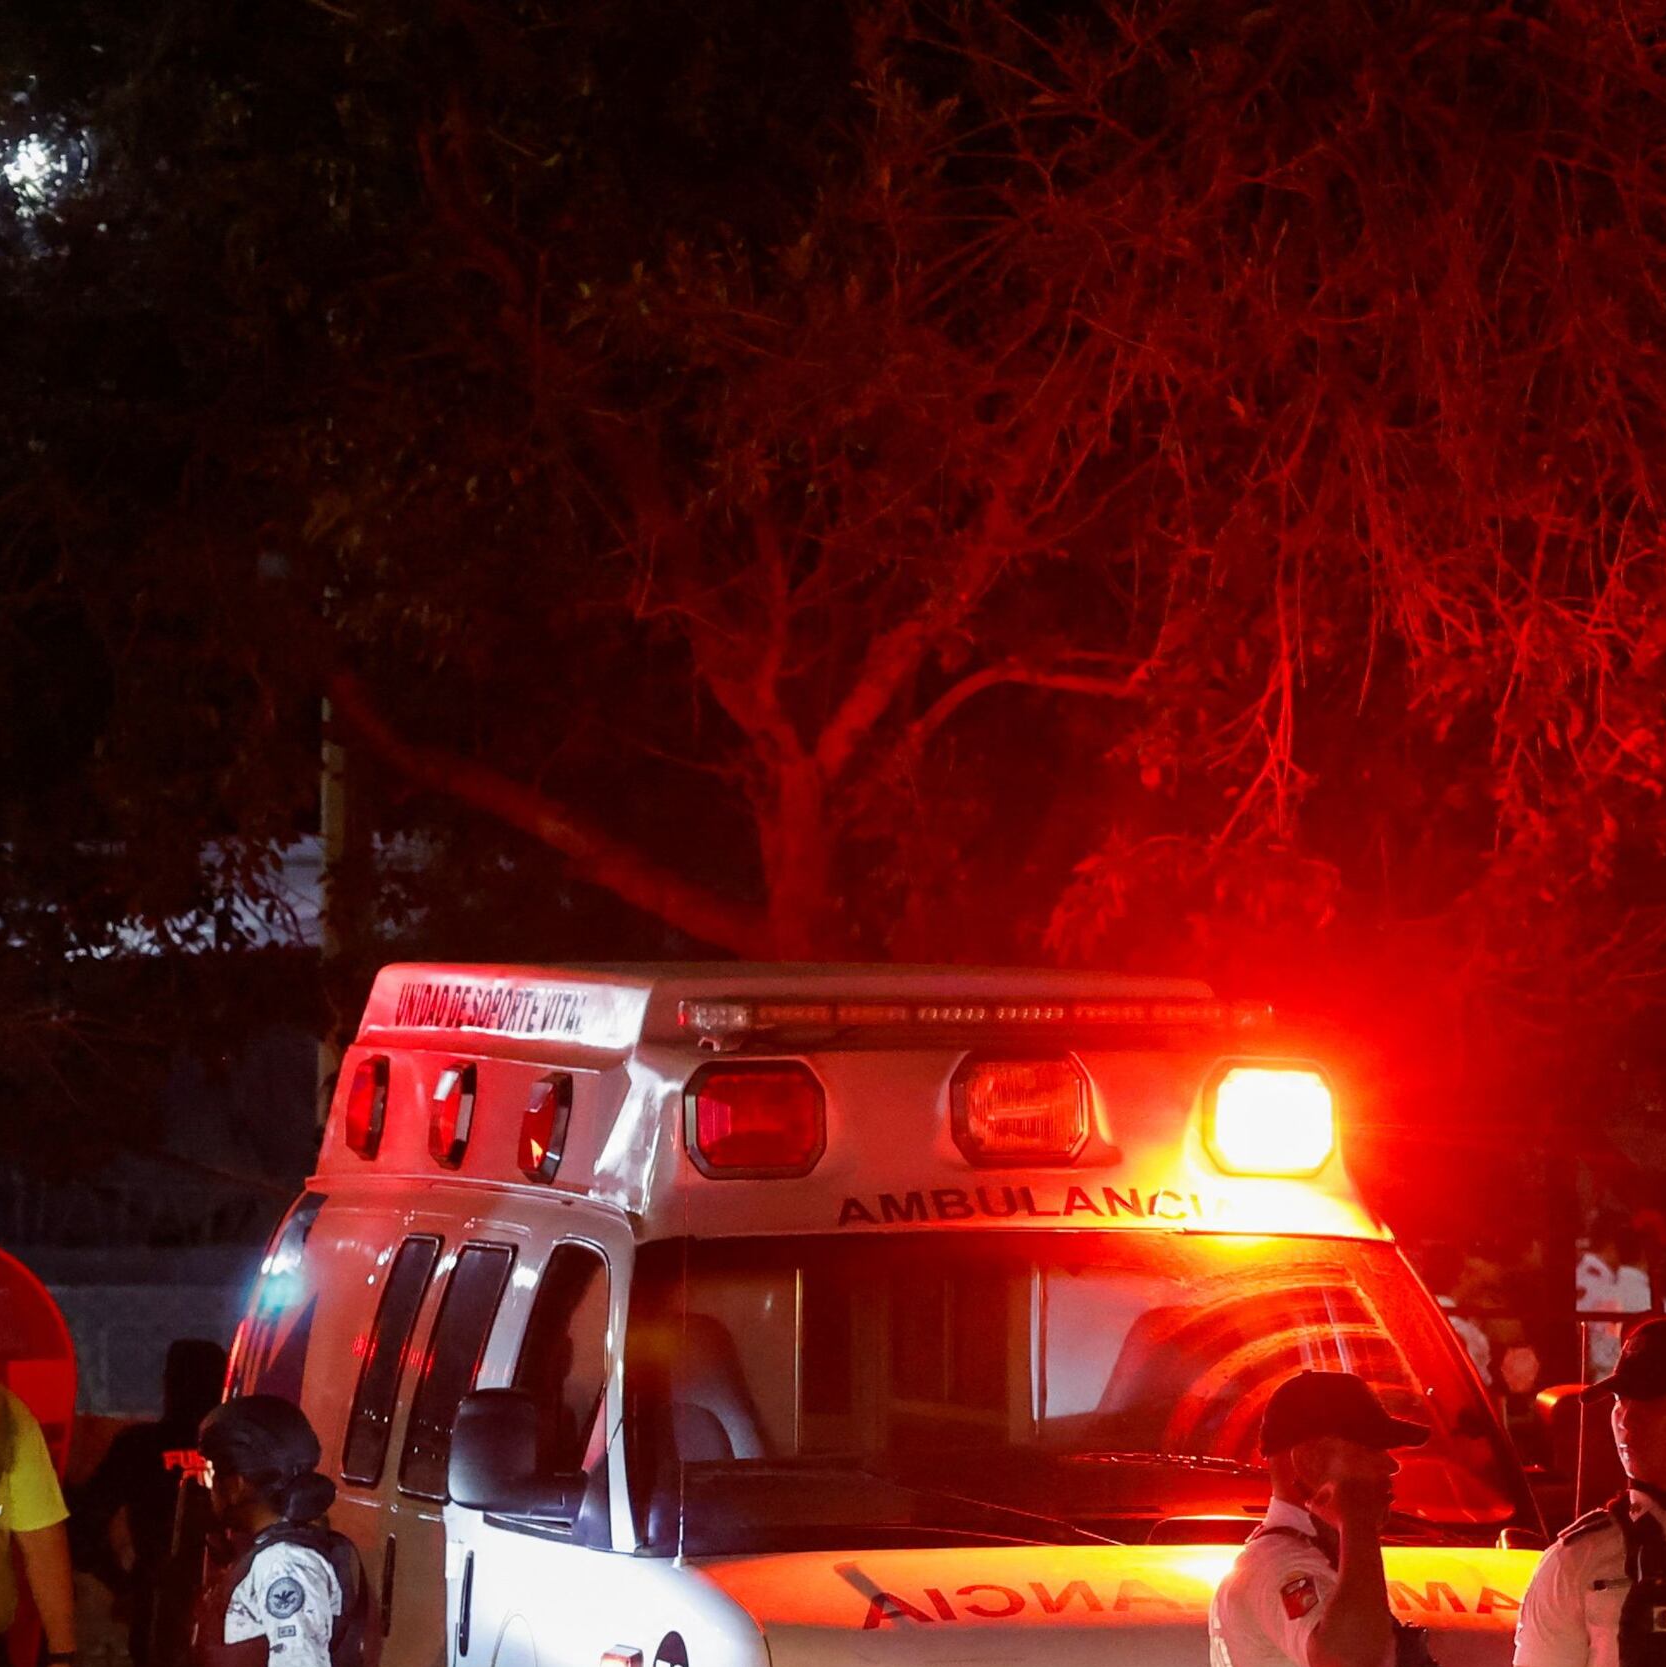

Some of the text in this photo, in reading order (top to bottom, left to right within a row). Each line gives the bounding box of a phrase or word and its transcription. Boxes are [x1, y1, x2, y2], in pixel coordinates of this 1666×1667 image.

[395, 982, 588, 1035] UNIDAD DE SOPORTE VITAL
